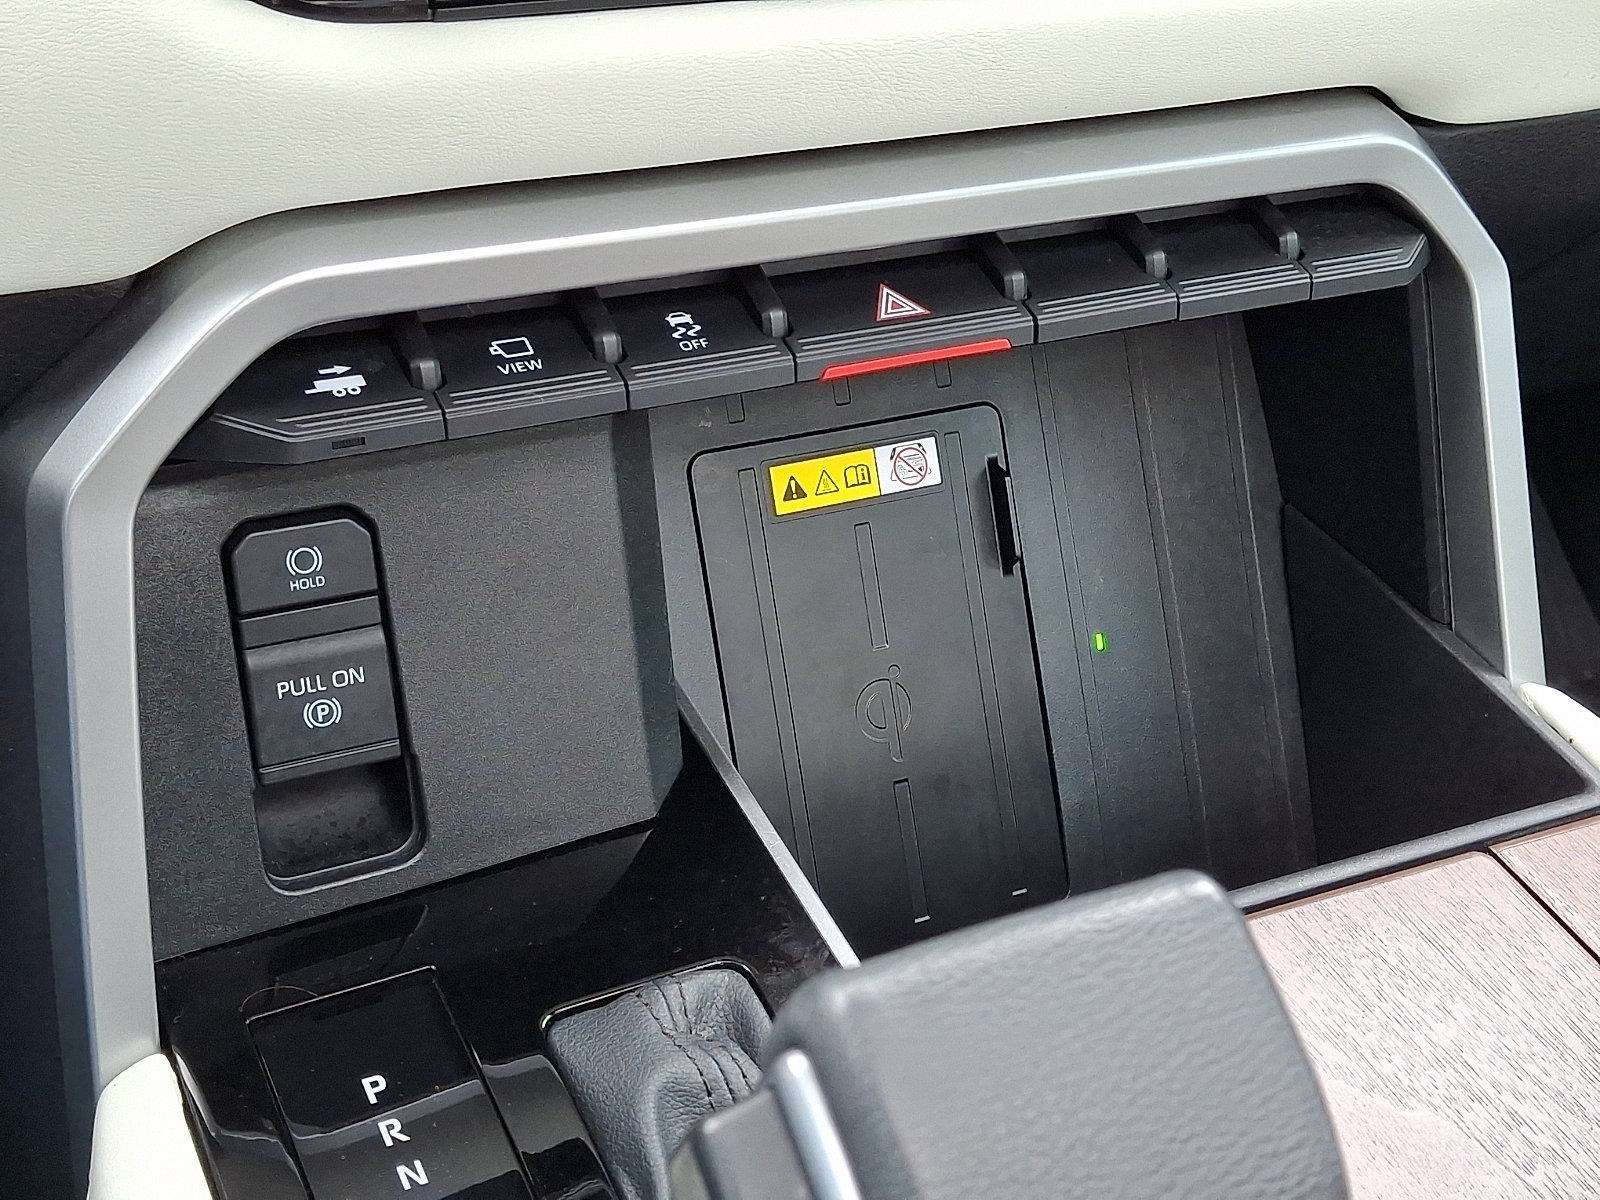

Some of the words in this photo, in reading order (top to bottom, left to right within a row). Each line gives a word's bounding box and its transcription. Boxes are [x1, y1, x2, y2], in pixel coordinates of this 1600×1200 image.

[679, 338, 709, 351] OFF
[497, 359, 543, 375] VIEW
[289, 576, 326, 591] HOLD
[277, 675, 327, 699] PULL
[332, 666, 365, 688] ON
[362, 1075, 387, 1105] P
[379, 1119, 411, 1147] R
[396, 1160, 429, 1191] N
